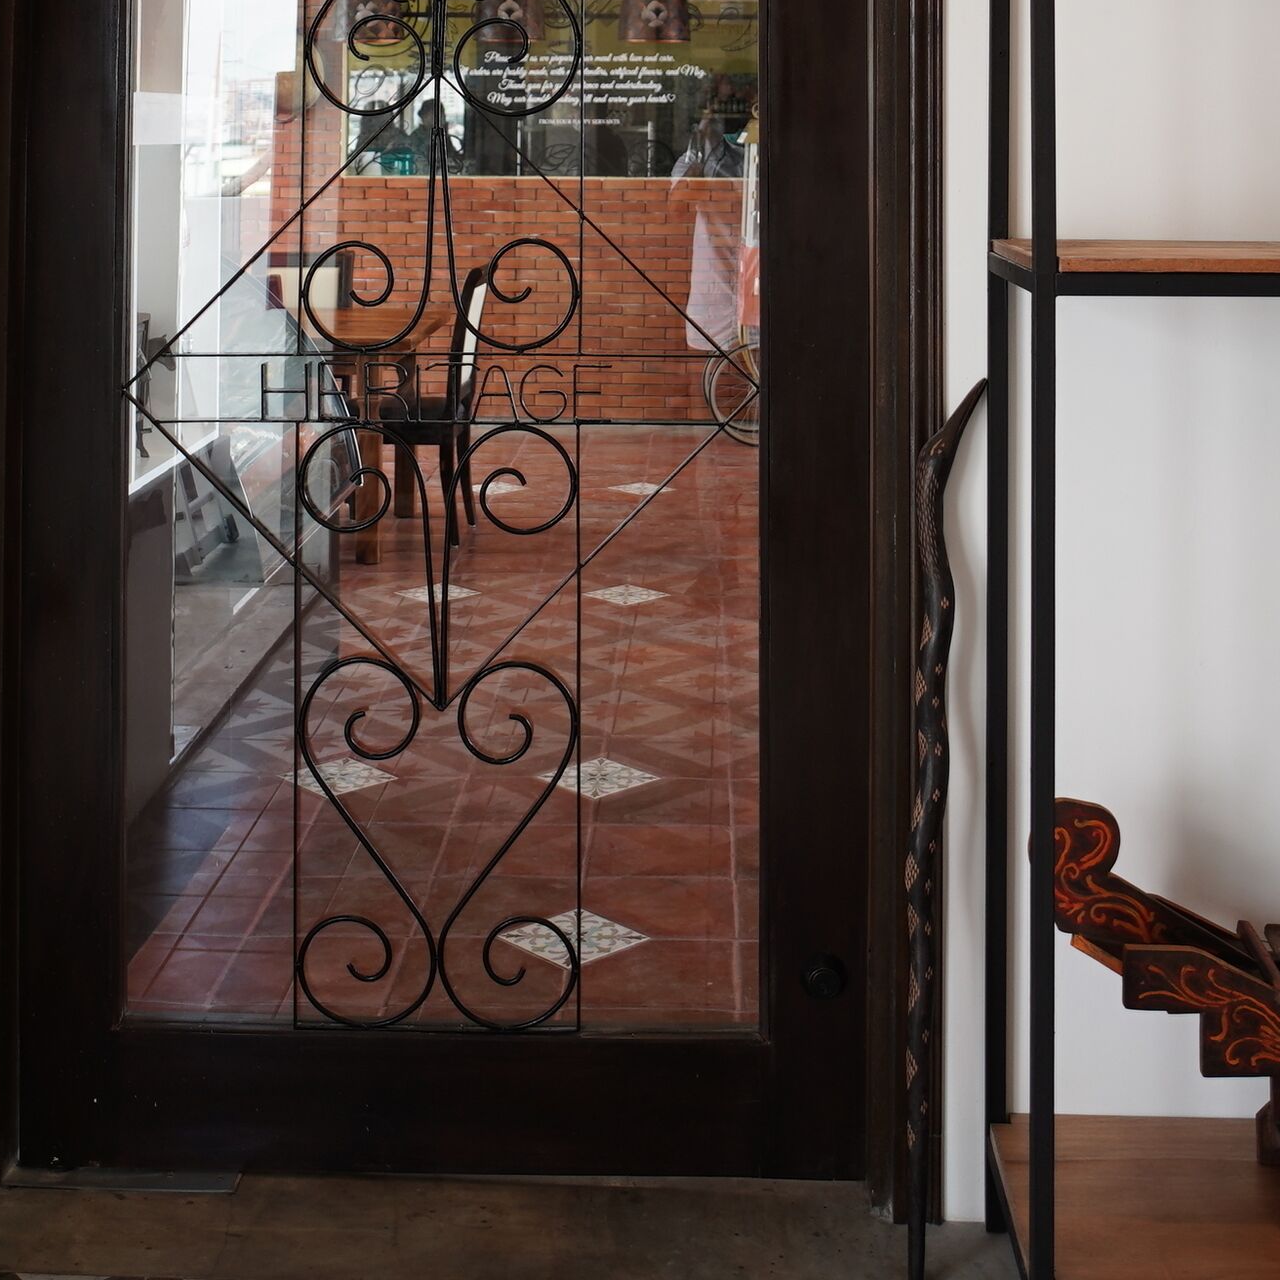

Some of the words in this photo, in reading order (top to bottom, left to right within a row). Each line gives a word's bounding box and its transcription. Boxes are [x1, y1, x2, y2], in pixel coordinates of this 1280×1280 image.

[644, 53, 659, 62] and
[665, 66, 681, 76] and
[600, 80, 616, 89] and
[487, 91, 513, 107] May
[593, 94, 608, 103] and
[261, 361, 613, 424] HERITAGE
